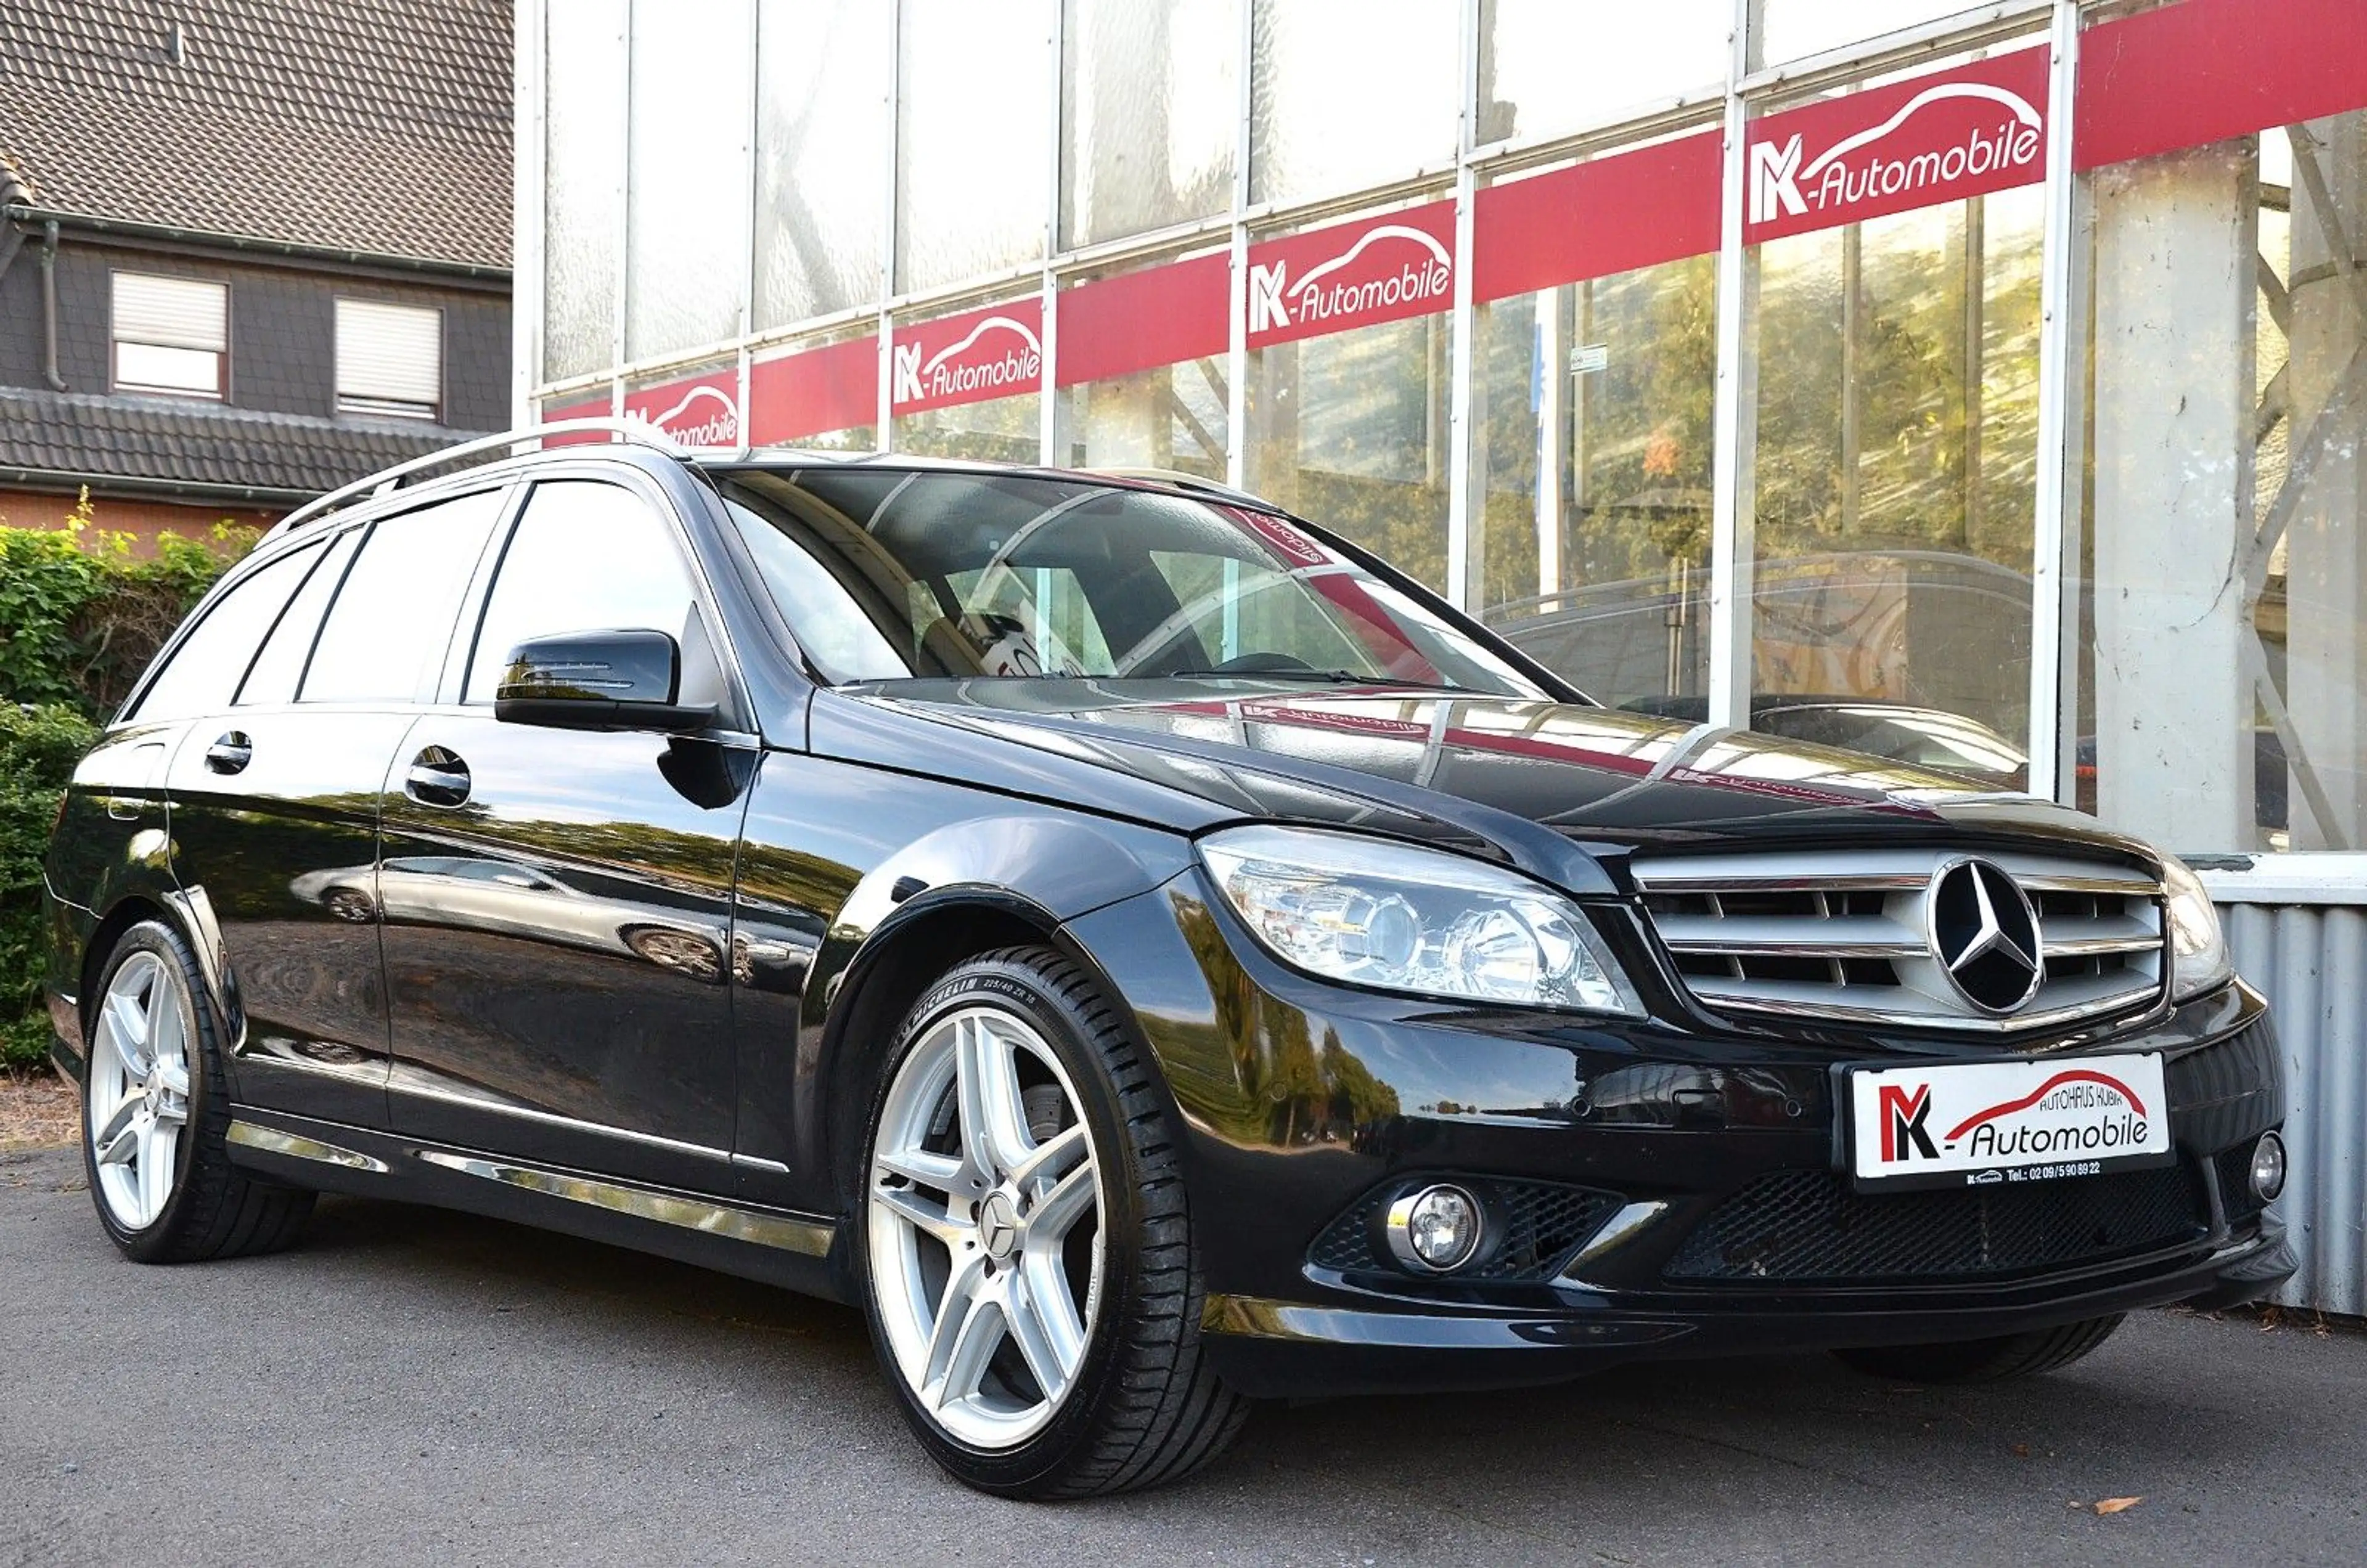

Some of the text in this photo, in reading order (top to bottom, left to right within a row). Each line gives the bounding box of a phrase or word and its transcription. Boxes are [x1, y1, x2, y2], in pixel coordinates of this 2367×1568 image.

[912, 978, 978, 1026] MICHELIN
[2039, 1085, 2095, 1111] AUTOHAUS
[2007, 1169, 2027, 1182] Tel.:
